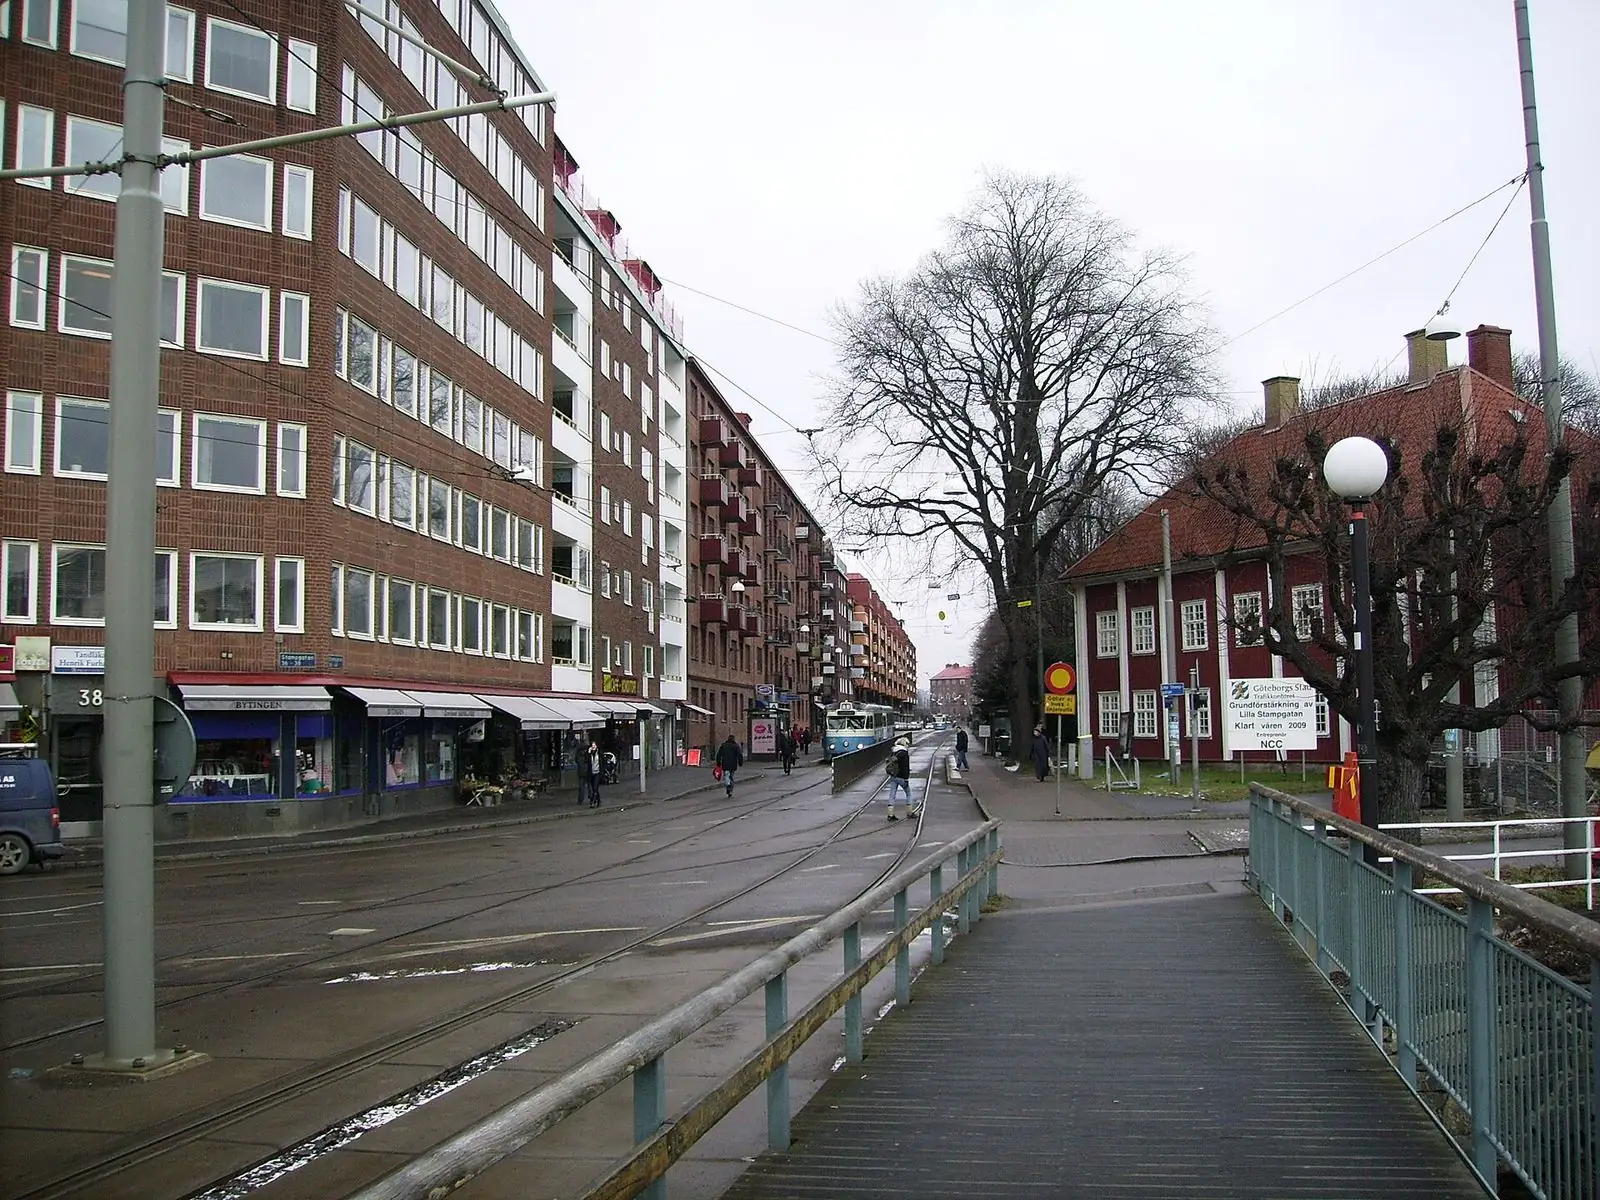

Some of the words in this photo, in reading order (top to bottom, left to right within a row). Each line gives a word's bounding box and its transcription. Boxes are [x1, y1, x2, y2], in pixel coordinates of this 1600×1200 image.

[1253, 684, 1293, 693] Göteborgs
[78, 689, 103, 706] 38
[235, 701, 282, 709] BYTINGEN
[1257, 711, 1303, 719] Stampgatan
[1260, 740, 1283, 749] NCC
[2, 775, 15, 783] AB
